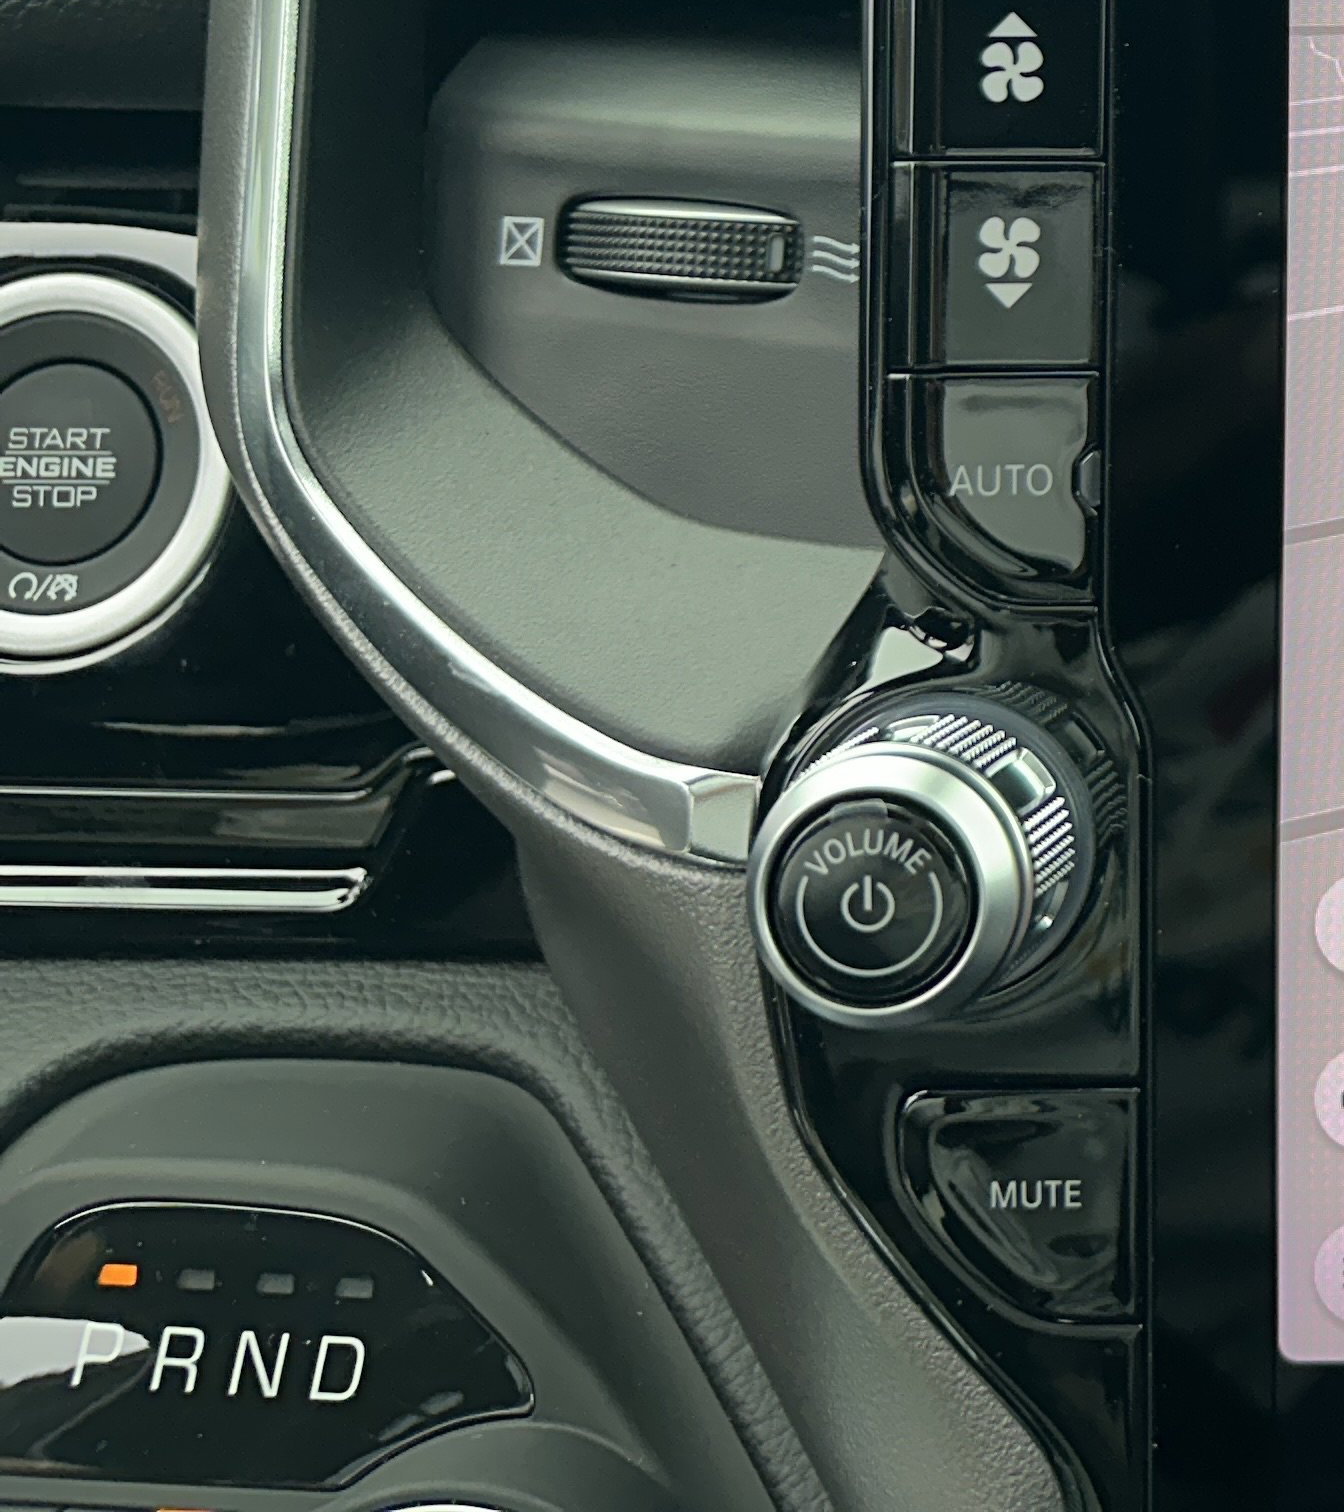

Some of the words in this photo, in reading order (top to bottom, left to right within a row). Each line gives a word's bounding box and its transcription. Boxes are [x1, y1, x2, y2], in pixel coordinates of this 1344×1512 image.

[8, 427, 111, 449] START
[0, 456, 117, 478] ENGINE
[949, 463, 1053, 497] AUTO
[12, 485, 98, 508] STOP
[804, 828, 933, 877] VOLUME
[989, 1179, 1082, 1210] MUTE
